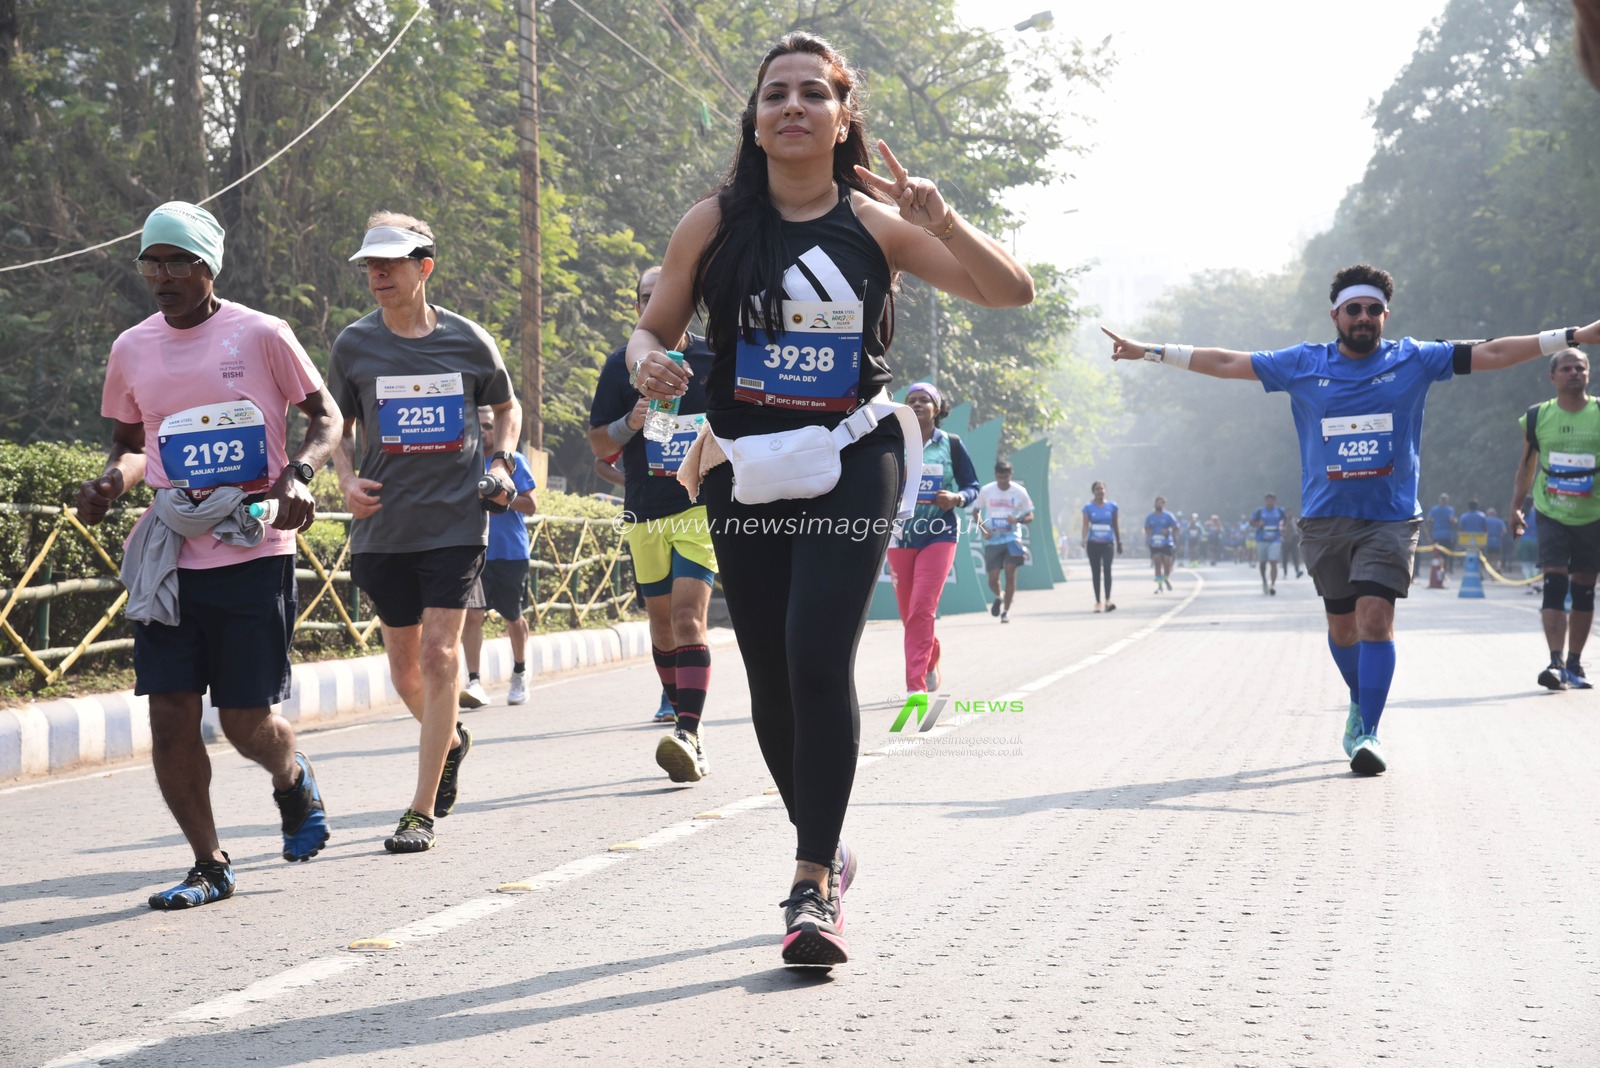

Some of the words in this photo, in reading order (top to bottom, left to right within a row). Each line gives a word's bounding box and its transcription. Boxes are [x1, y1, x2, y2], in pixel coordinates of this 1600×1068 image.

[764, 344, 834, 372] 3938
[853, 352, 858, 361] KM
[397, 406, 445, 426] 2251
[182, 440, 245, 467] 2193
[661, 440, 693, 456] 327
[1338, 440, 1378, 456] 4282
[216, 465, 241, 473] JADHAV
